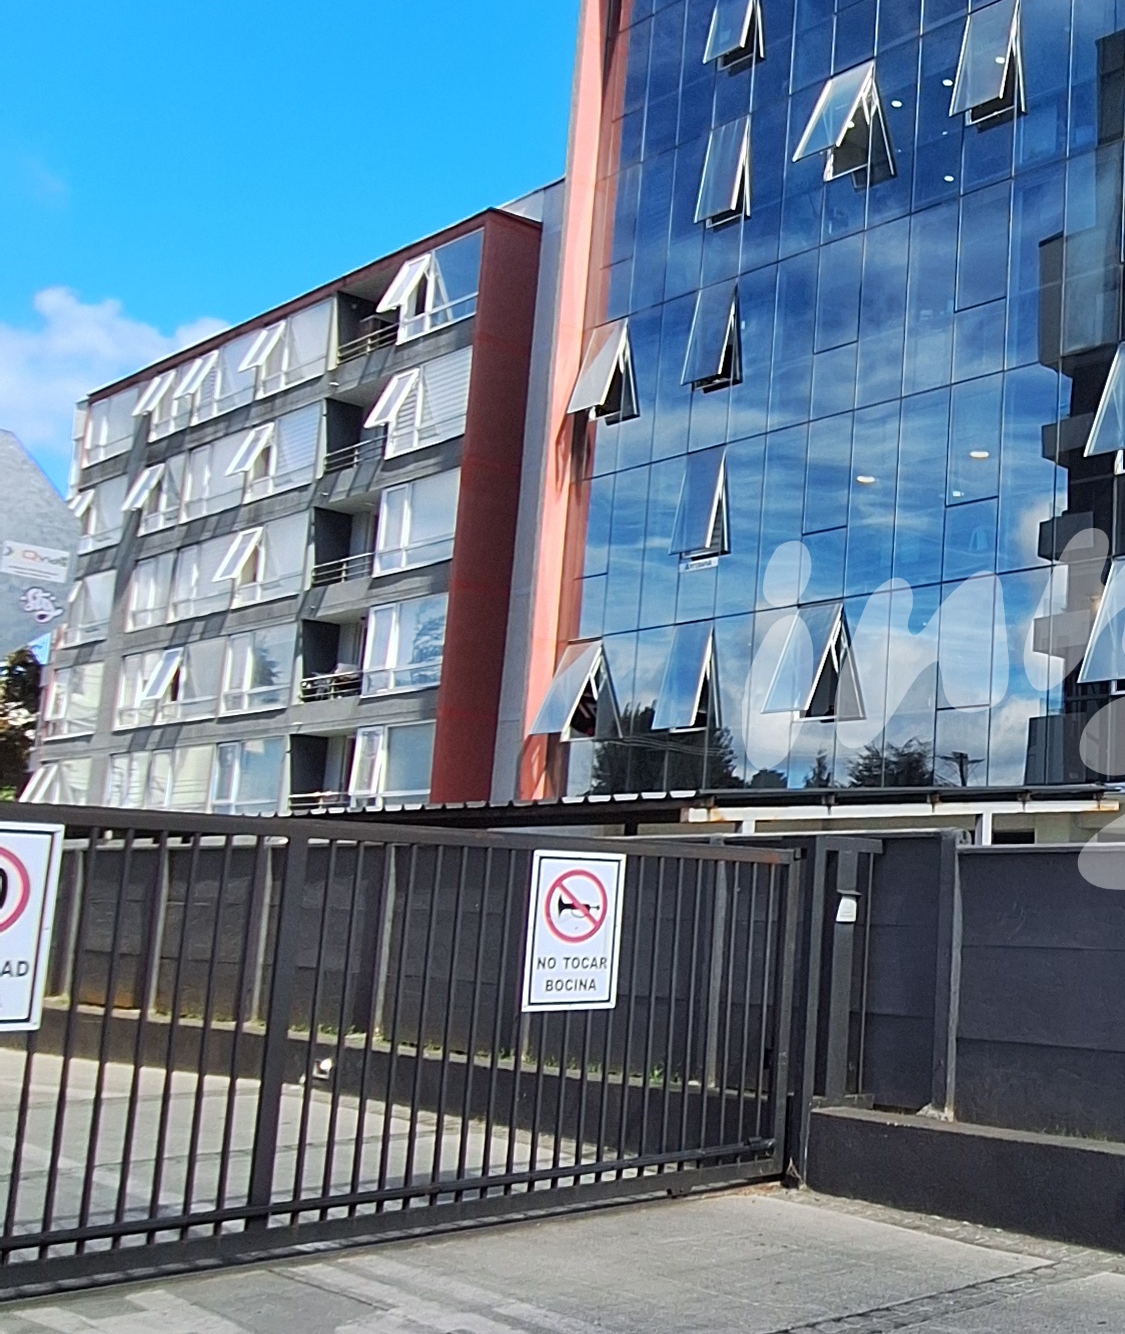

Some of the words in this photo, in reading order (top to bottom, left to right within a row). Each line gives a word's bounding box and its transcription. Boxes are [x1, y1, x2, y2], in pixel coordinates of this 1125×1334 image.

[537, 957, 557, 970] NO
[563, 956, 608, 969] TOCAR
[545, 979, 597, 992] BOCINA
